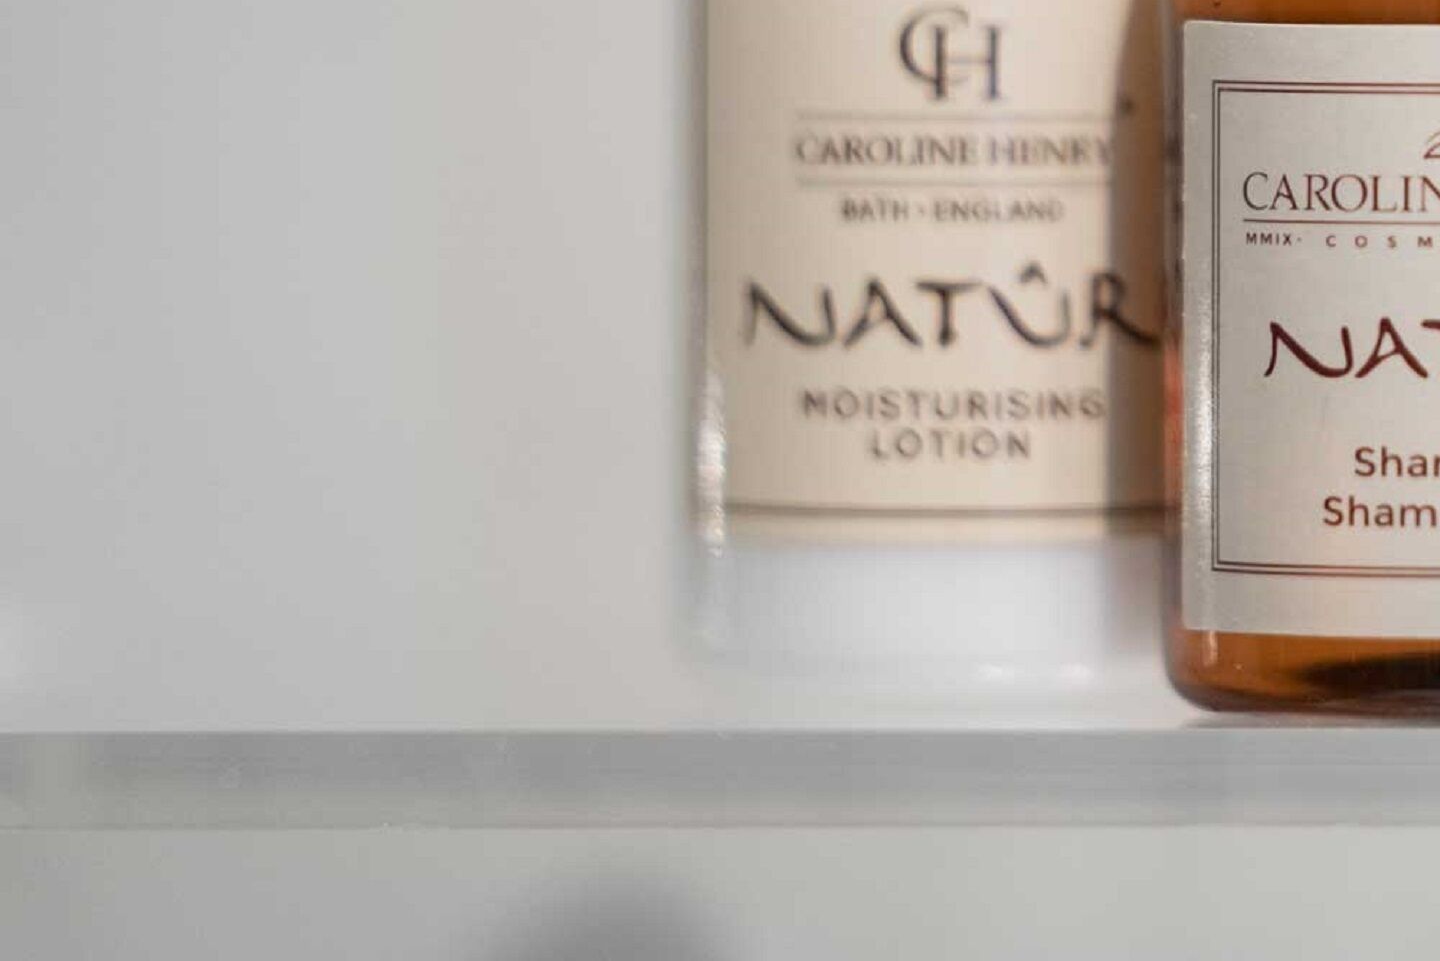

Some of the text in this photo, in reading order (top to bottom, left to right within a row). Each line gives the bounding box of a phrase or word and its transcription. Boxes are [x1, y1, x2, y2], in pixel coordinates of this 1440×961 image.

[796, 136, 1113, 166] CAROLINE HENRY
[841, 198, 1065, 224] BATH ENGLAND
[802, 389, 1106, 419] MOISTURISING
[872, 431, 1032, 461] LOTION
